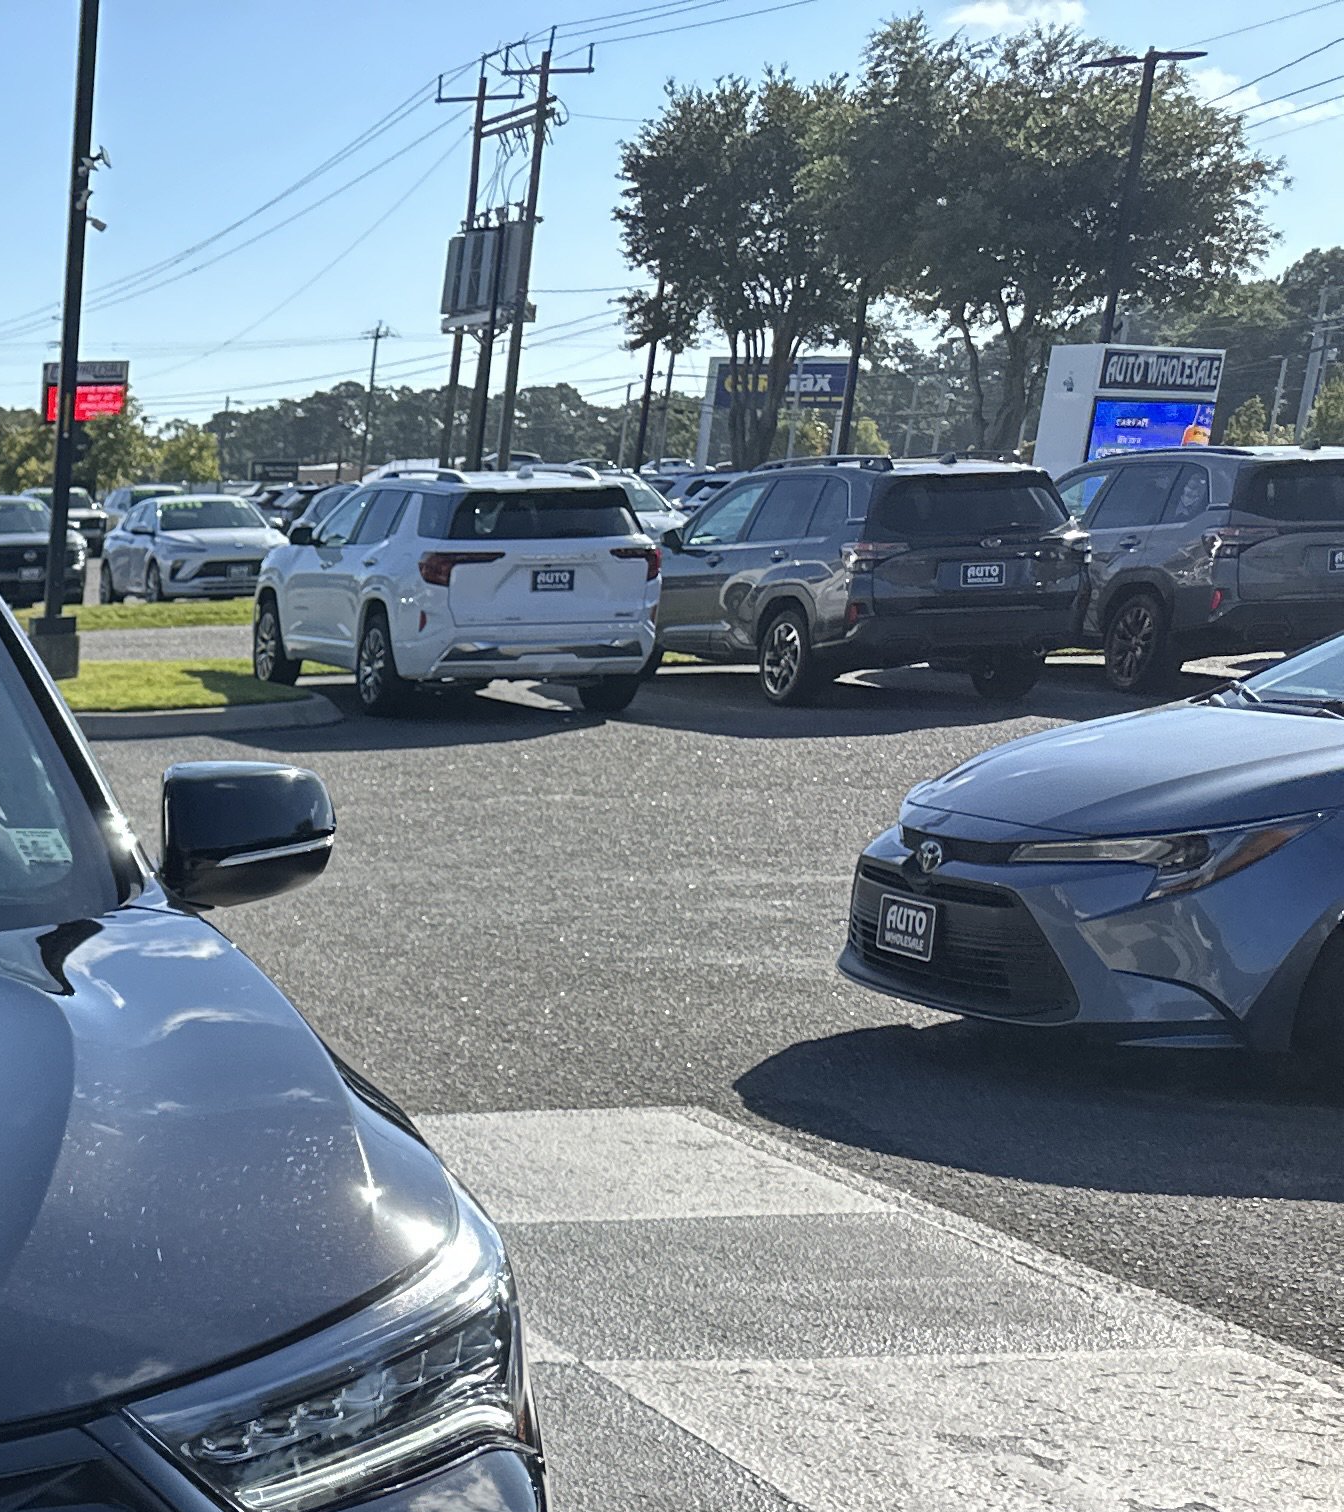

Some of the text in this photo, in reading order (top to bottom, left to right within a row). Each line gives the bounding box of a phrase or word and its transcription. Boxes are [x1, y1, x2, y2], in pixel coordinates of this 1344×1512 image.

[1105, 354, 1220, 387] AUTO WHOLESALE
[537, 572, 570, 583] AUTO
[967, 565, 999, 578] AUTO
[886, 904, 927, 936] AUTO
[884, 929, 924, 952] WHOLESALE
